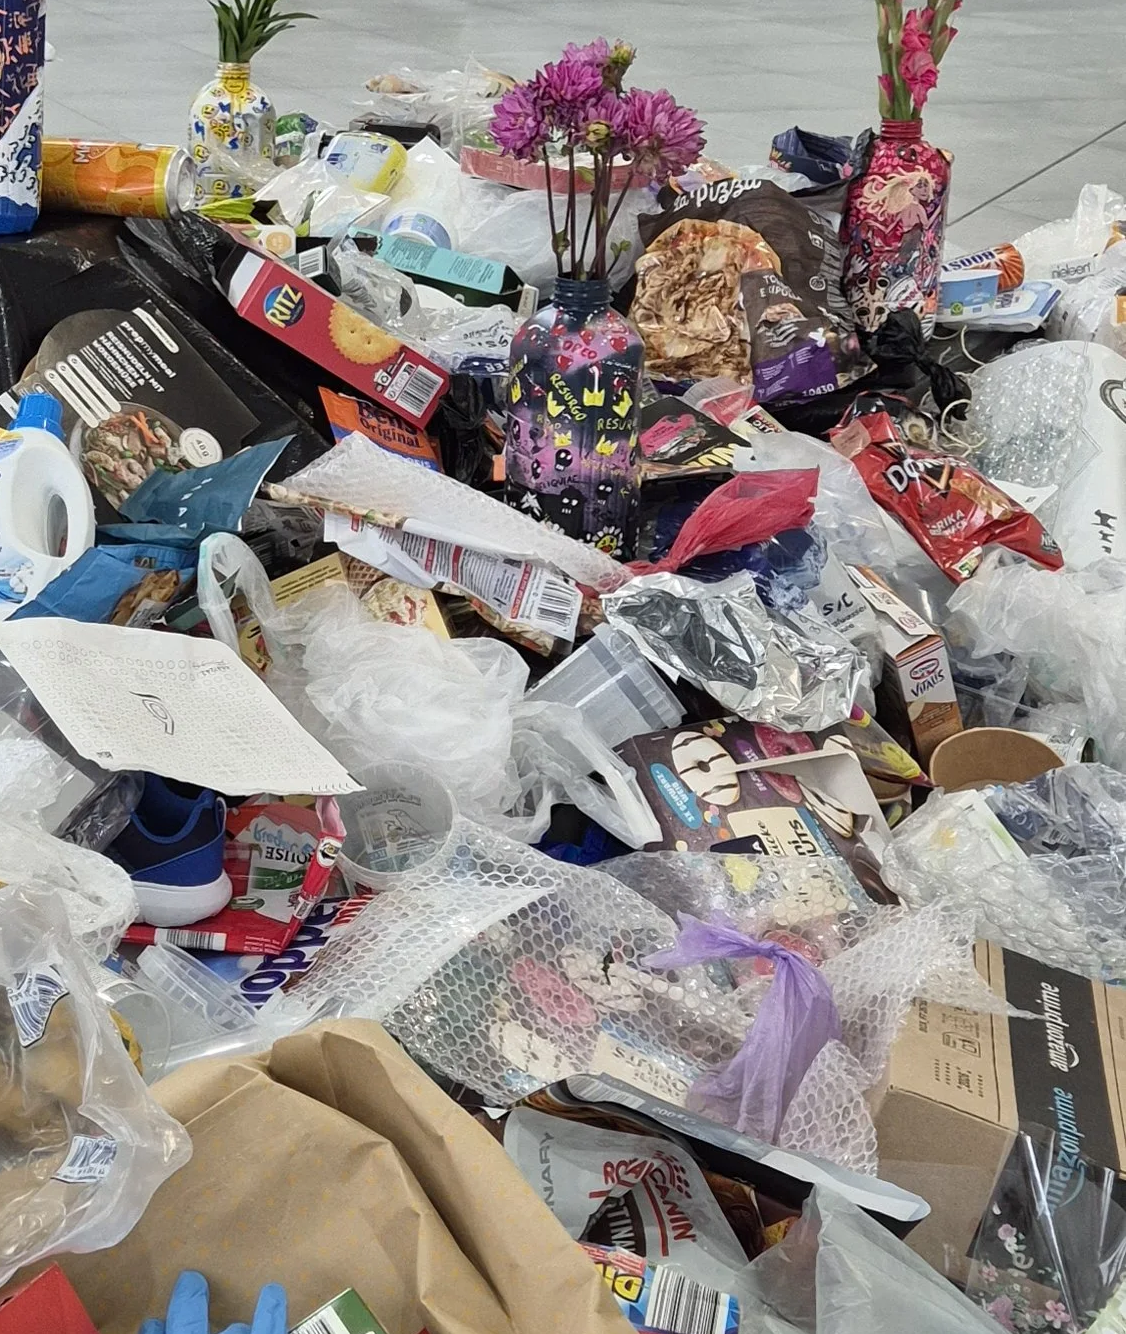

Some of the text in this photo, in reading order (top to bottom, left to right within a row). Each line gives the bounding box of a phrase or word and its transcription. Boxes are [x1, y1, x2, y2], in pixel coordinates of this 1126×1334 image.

[265, 282, 304, 329] RITZ
[549, 372, 587, 422] RESURGO
[360, 417, 421, 449] Original
[910, 669, 946, 698] VITALIS
[649, 1166, 697, 1243] CANIN
